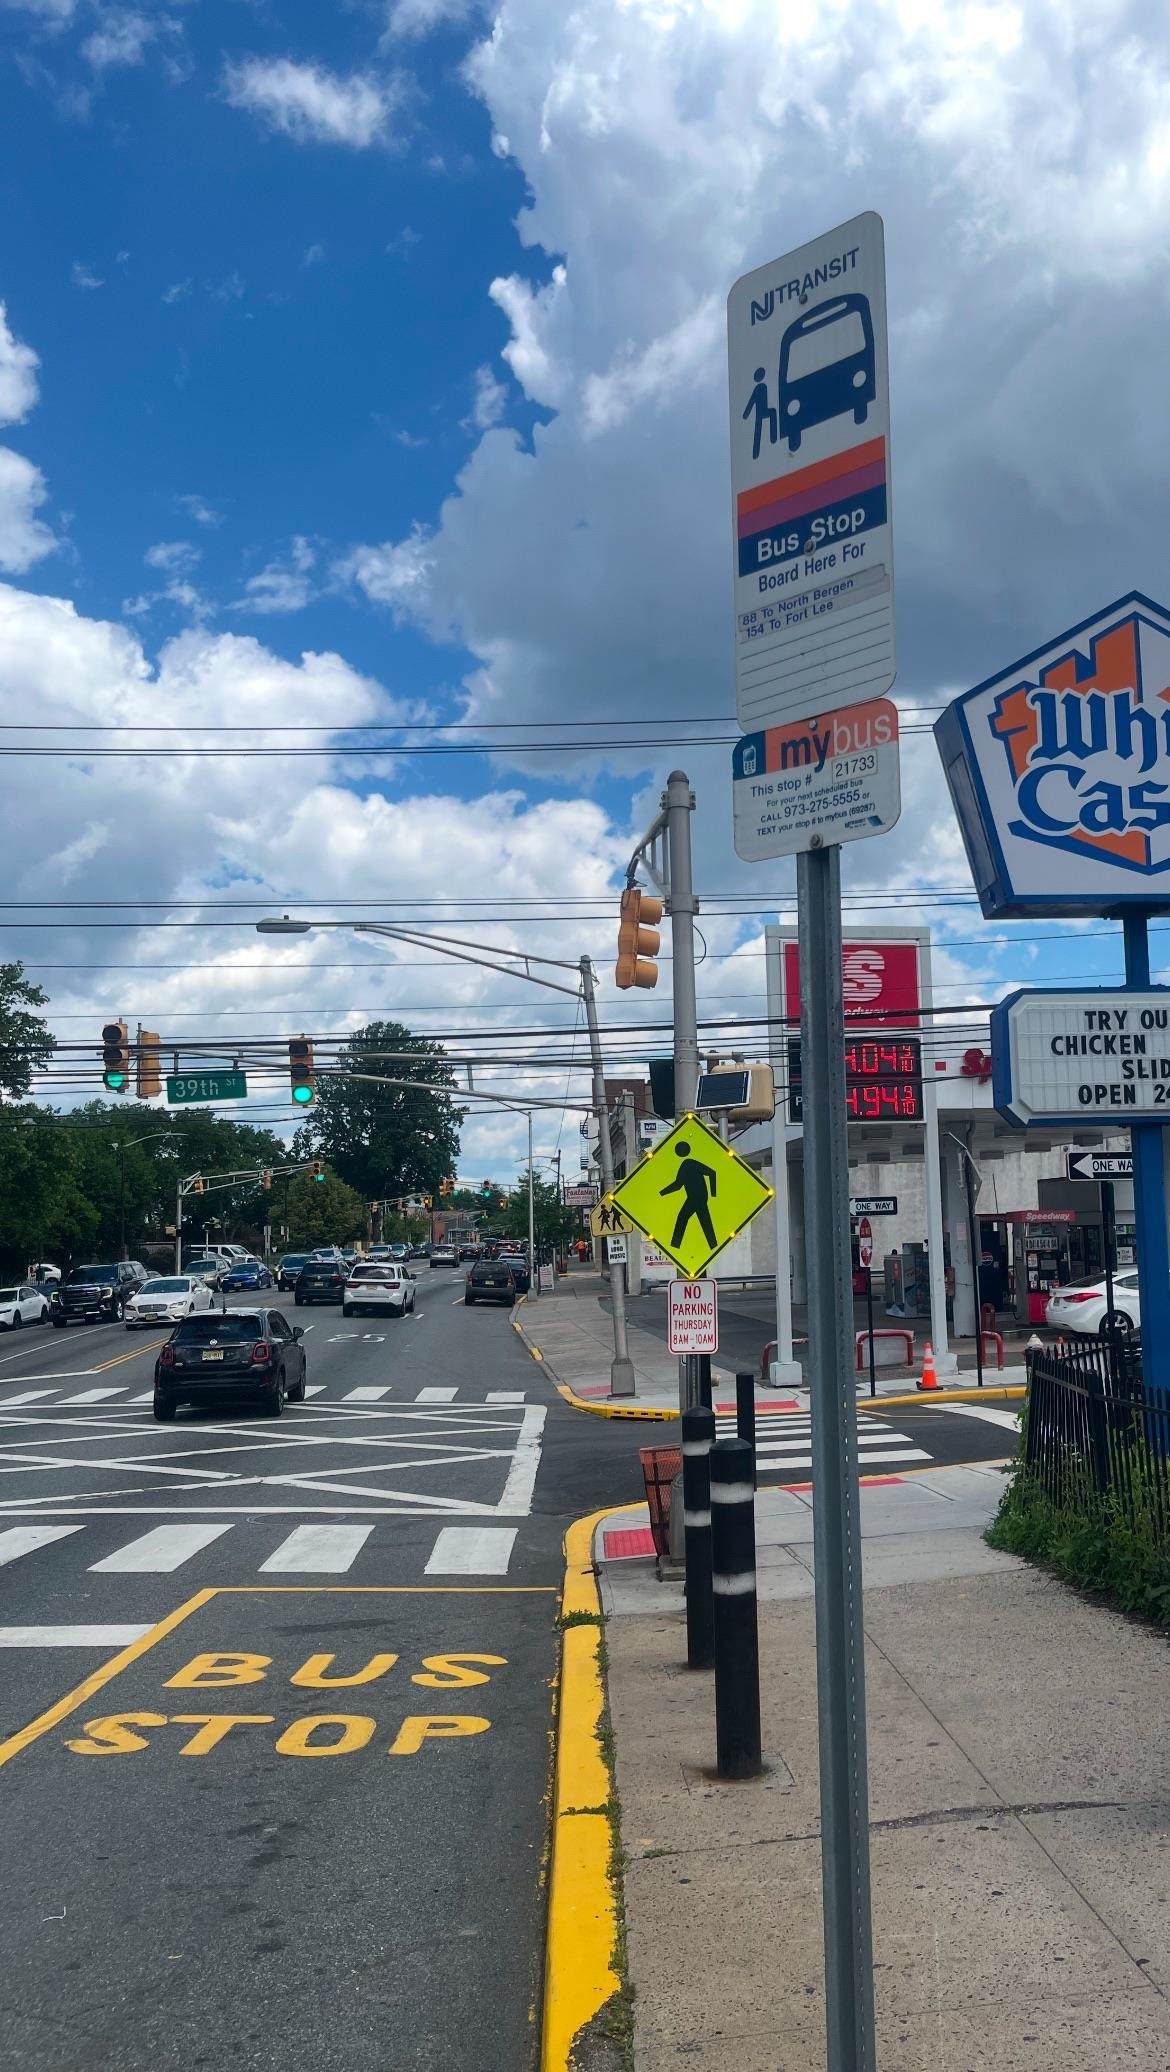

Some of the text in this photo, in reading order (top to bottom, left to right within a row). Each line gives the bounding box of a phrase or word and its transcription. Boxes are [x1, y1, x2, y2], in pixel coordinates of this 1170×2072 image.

[758, 508, 866, 562] Bus Stop
[758, 541, 866, 592] Board Here For
[742, 580, 854, 626] 88 To North Bergen
[747, 601, 833, 638] 154 To Fort Lee
[781, 715, 892, 774] mybus
[750, 755, 875, 798] This stop # 21733
[798, 792, 813, 800] next
[814, 782, 848, 796] scheduled
[760, 813, 782, 823] CALL
[784, 790, 860, 818] 973-275-5555
[757, 826, 776, 836] TEXT
[778, 823, 792, 834] your
[824, 810, 848, 821] mybus
[1084, 1010, 1168, 1030] TRY OU
[1051, 1034, 1146, 1056] CHICKEN
[1122, 1059, 1170, 1079] SLID
[175, 1080, 219, 1098] 39th
[1078, 1084, 1136, 1104] OPEN
[1092, 1160, 1114, 1172] ONE
[856, 1202, 892, 1211] ONE WAY
[1026, 1212, 1070, 1222] Speedway
[684, 1286, 702, 1299] NO
[672, 1302, 713, 1316] PARKING
[674, 1320, 712, 1330] THURSDAY
[161, 1652, 509, 1689] BUS
[63, 1711, 493, 1757] STOP
